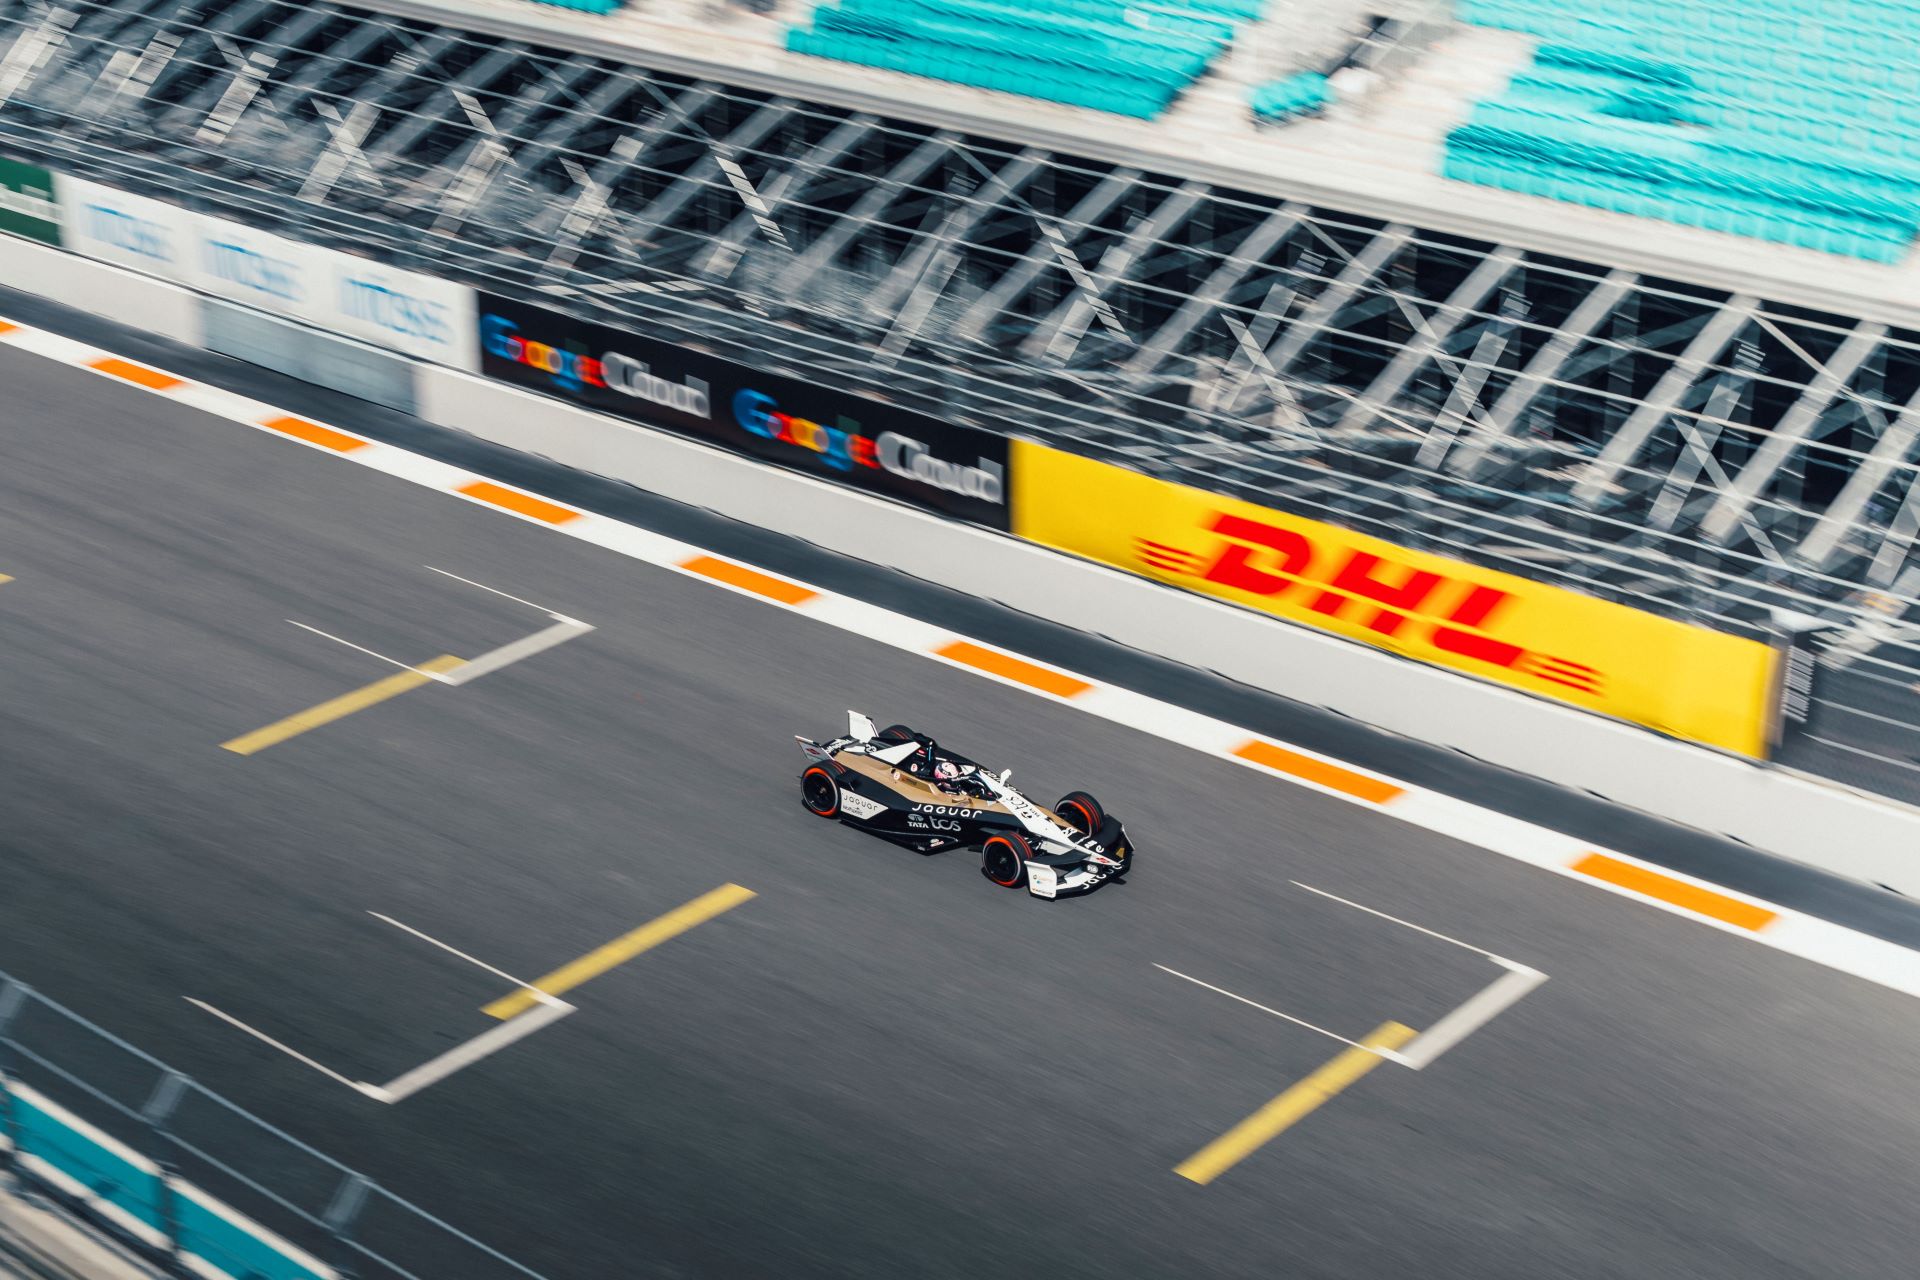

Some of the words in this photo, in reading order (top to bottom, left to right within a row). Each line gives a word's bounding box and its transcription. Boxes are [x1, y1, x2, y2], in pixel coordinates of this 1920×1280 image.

[480, 312, 608, 393] Google
[602, 350, 712, 420] Cloud
[732, 388, 882, 472] Google
[876, 430, 1004, 505] Cloud
[1201, 511, 1526, 669] DHL
[907, 820, 930, 829] TATA
[928, 815, 962, 832] tcs
